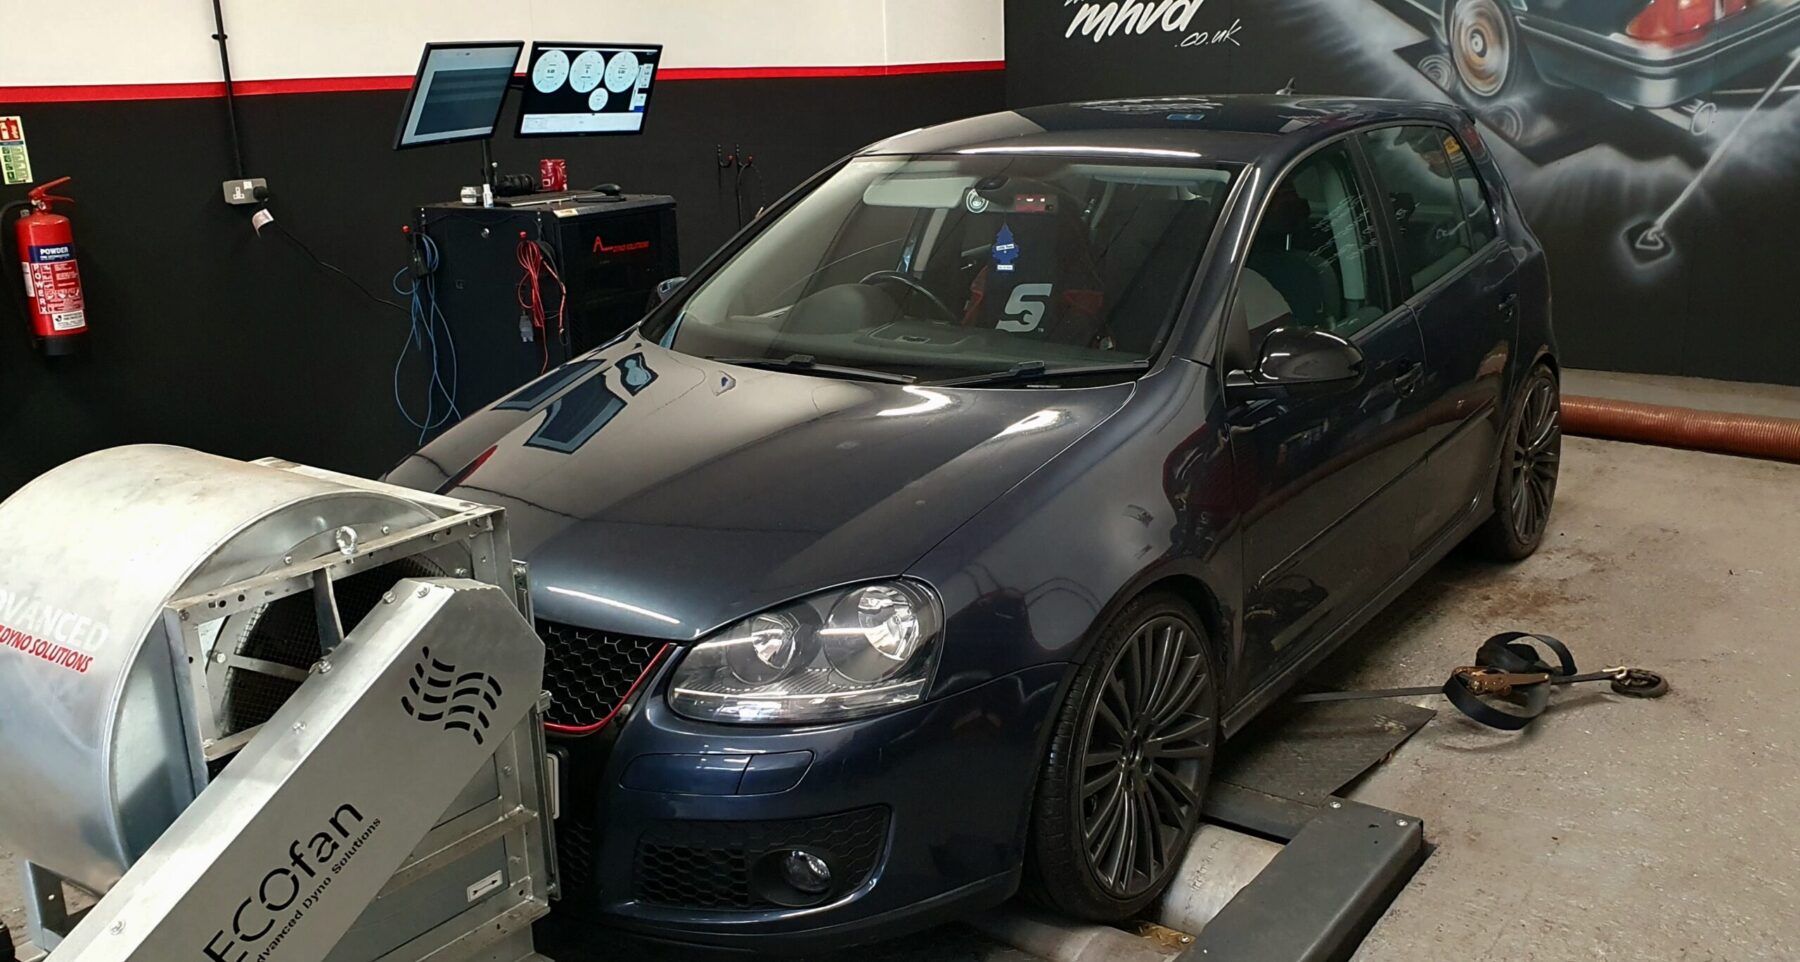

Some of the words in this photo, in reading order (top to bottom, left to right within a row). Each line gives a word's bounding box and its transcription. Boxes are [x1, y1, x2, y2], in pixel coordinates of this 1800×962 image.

[28, 638, 94, 673] SOLUTIONS
[302, 876, 332, 910] Dyno
[331, 817, 381, 874] Solutions
